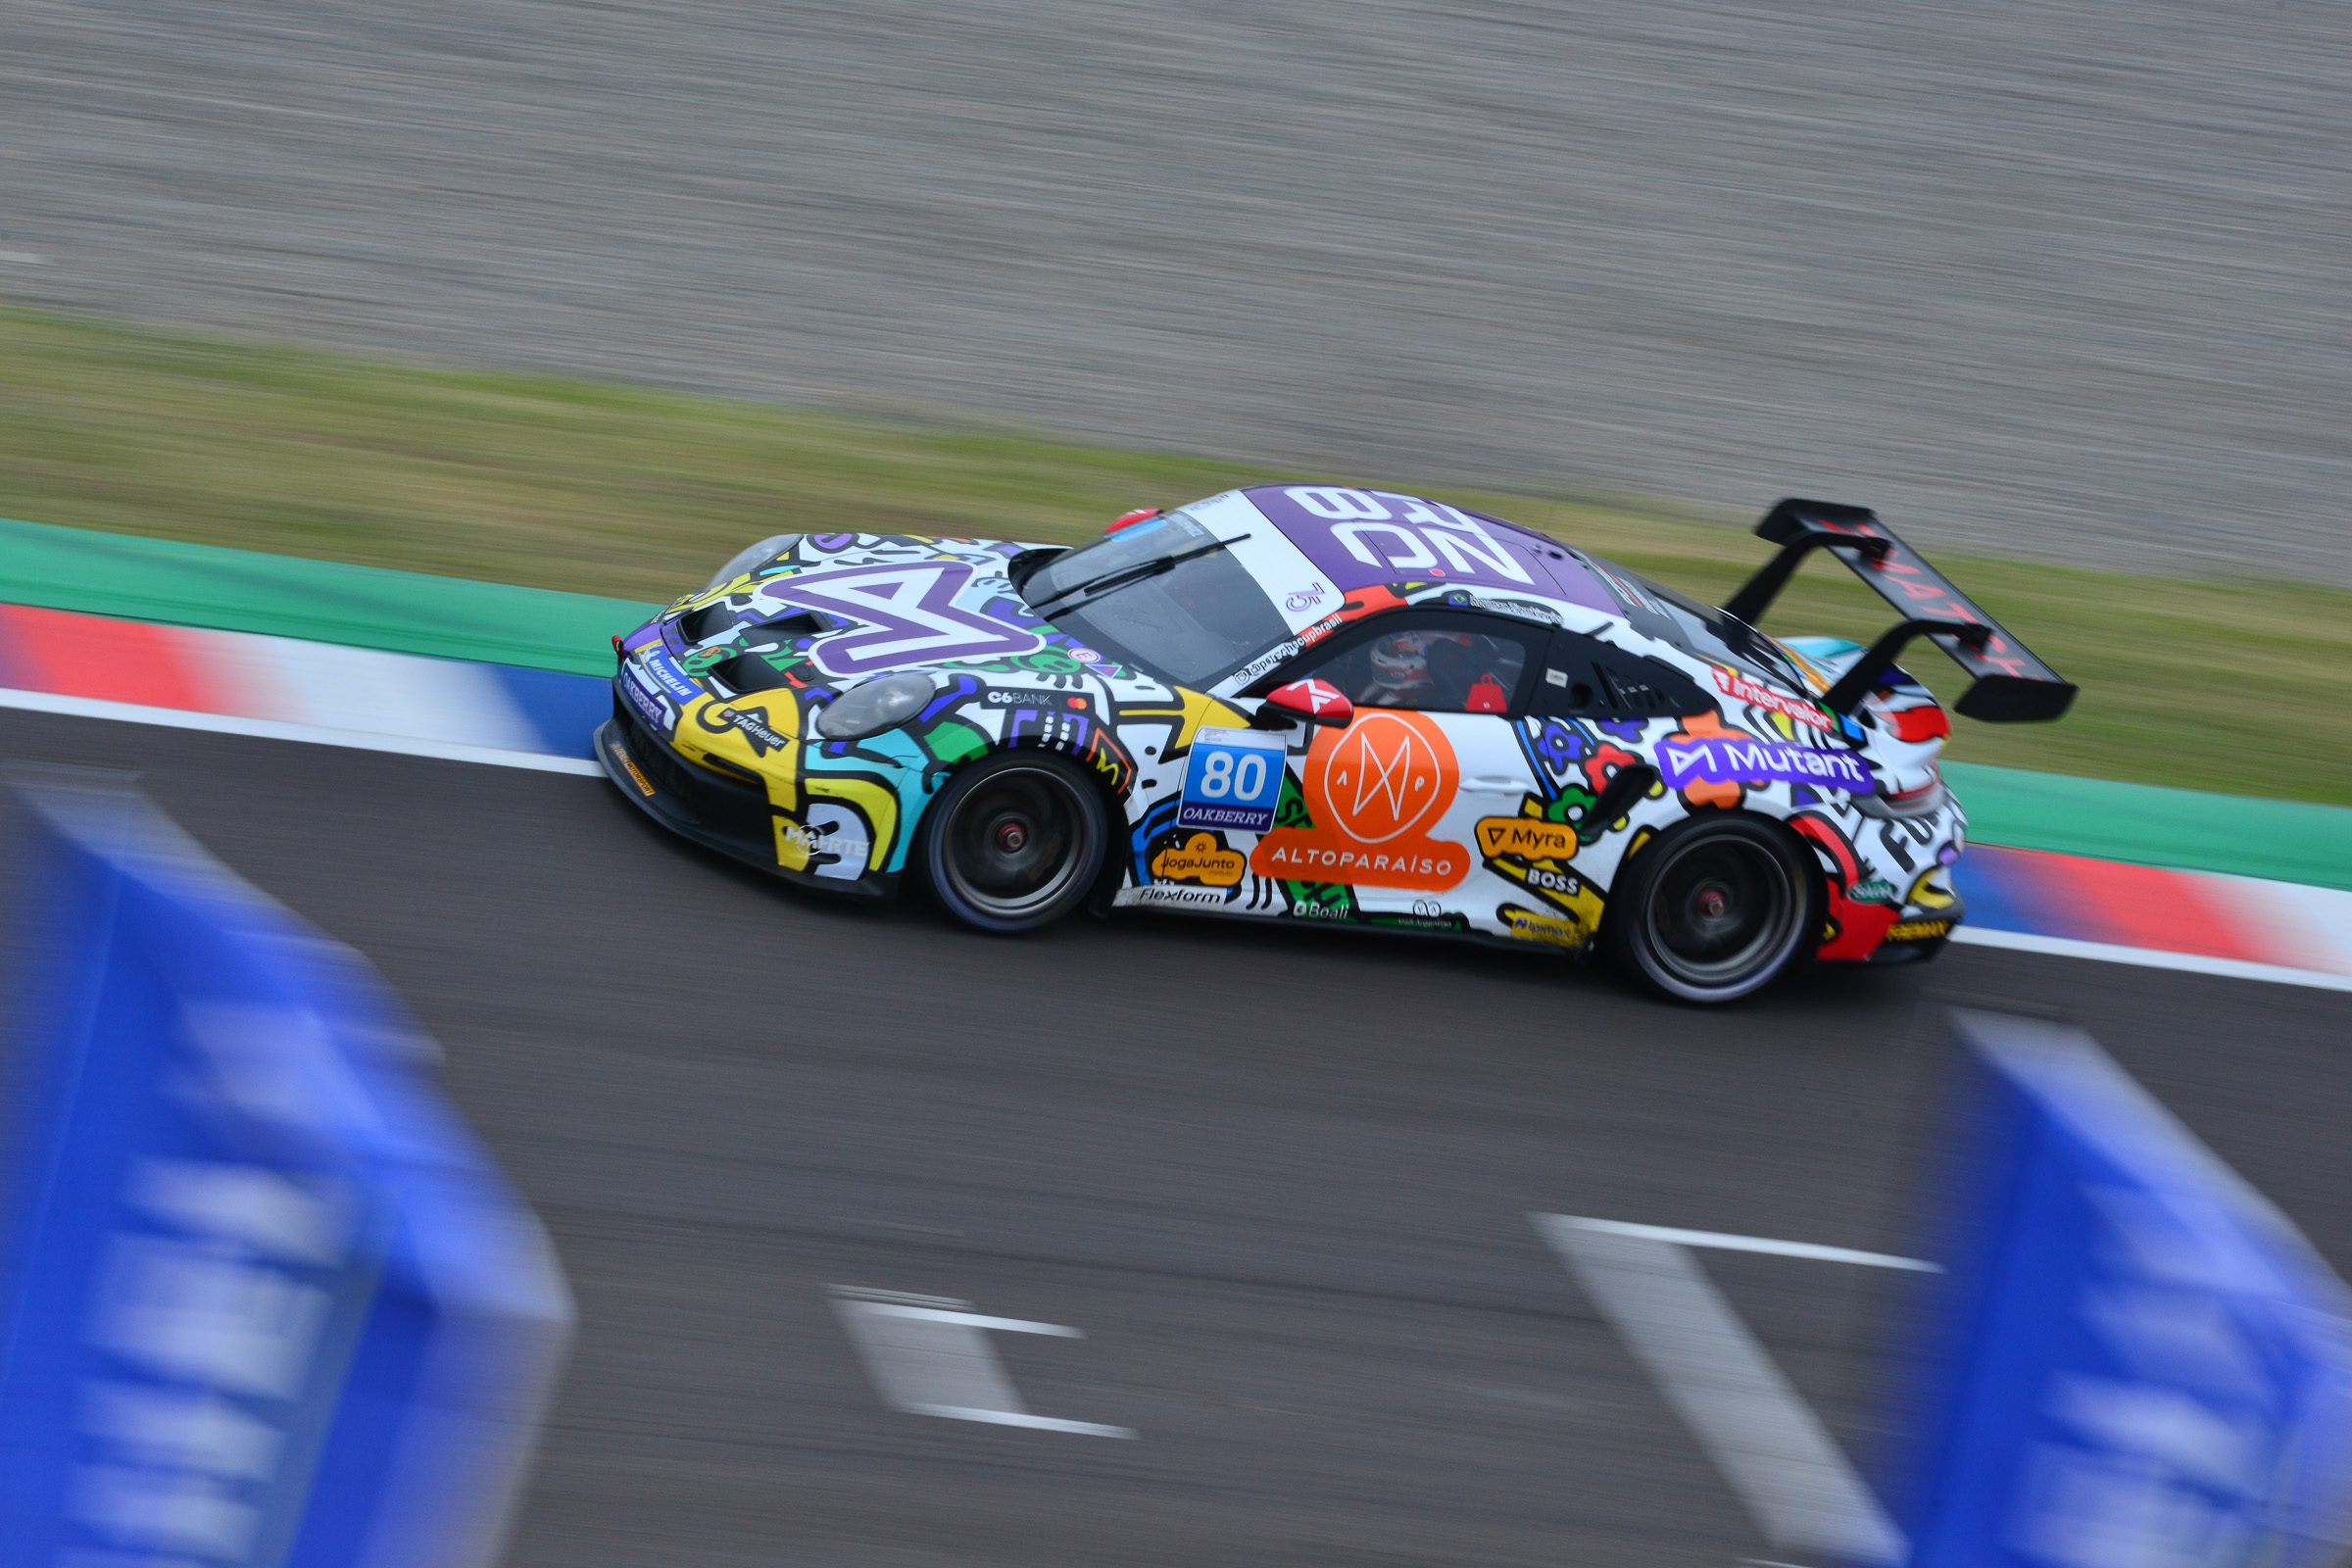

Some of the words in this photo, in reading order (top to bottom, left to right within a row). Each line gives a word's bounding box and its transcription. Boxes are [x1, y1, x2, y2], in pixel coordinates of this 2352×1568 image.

[649, 658, 693, 697] MICHELIN
[1722, 742, 1865, 783] Mutant
[1200, 751, 1267, 801] 80
[1183, 808, 1268, 825] OAKBERRY
[1512, 827, 1566, 850] Myra
[1161, 858, 1235, 870] JogaJunto
[1271, 846, 1452, 876] ALTOPARAÍSO
[1527, 867, 1580, 895] BOSS
[1140, 889, 1221, 904] Flexform
[1308, 902, 1349, 919] Boali
